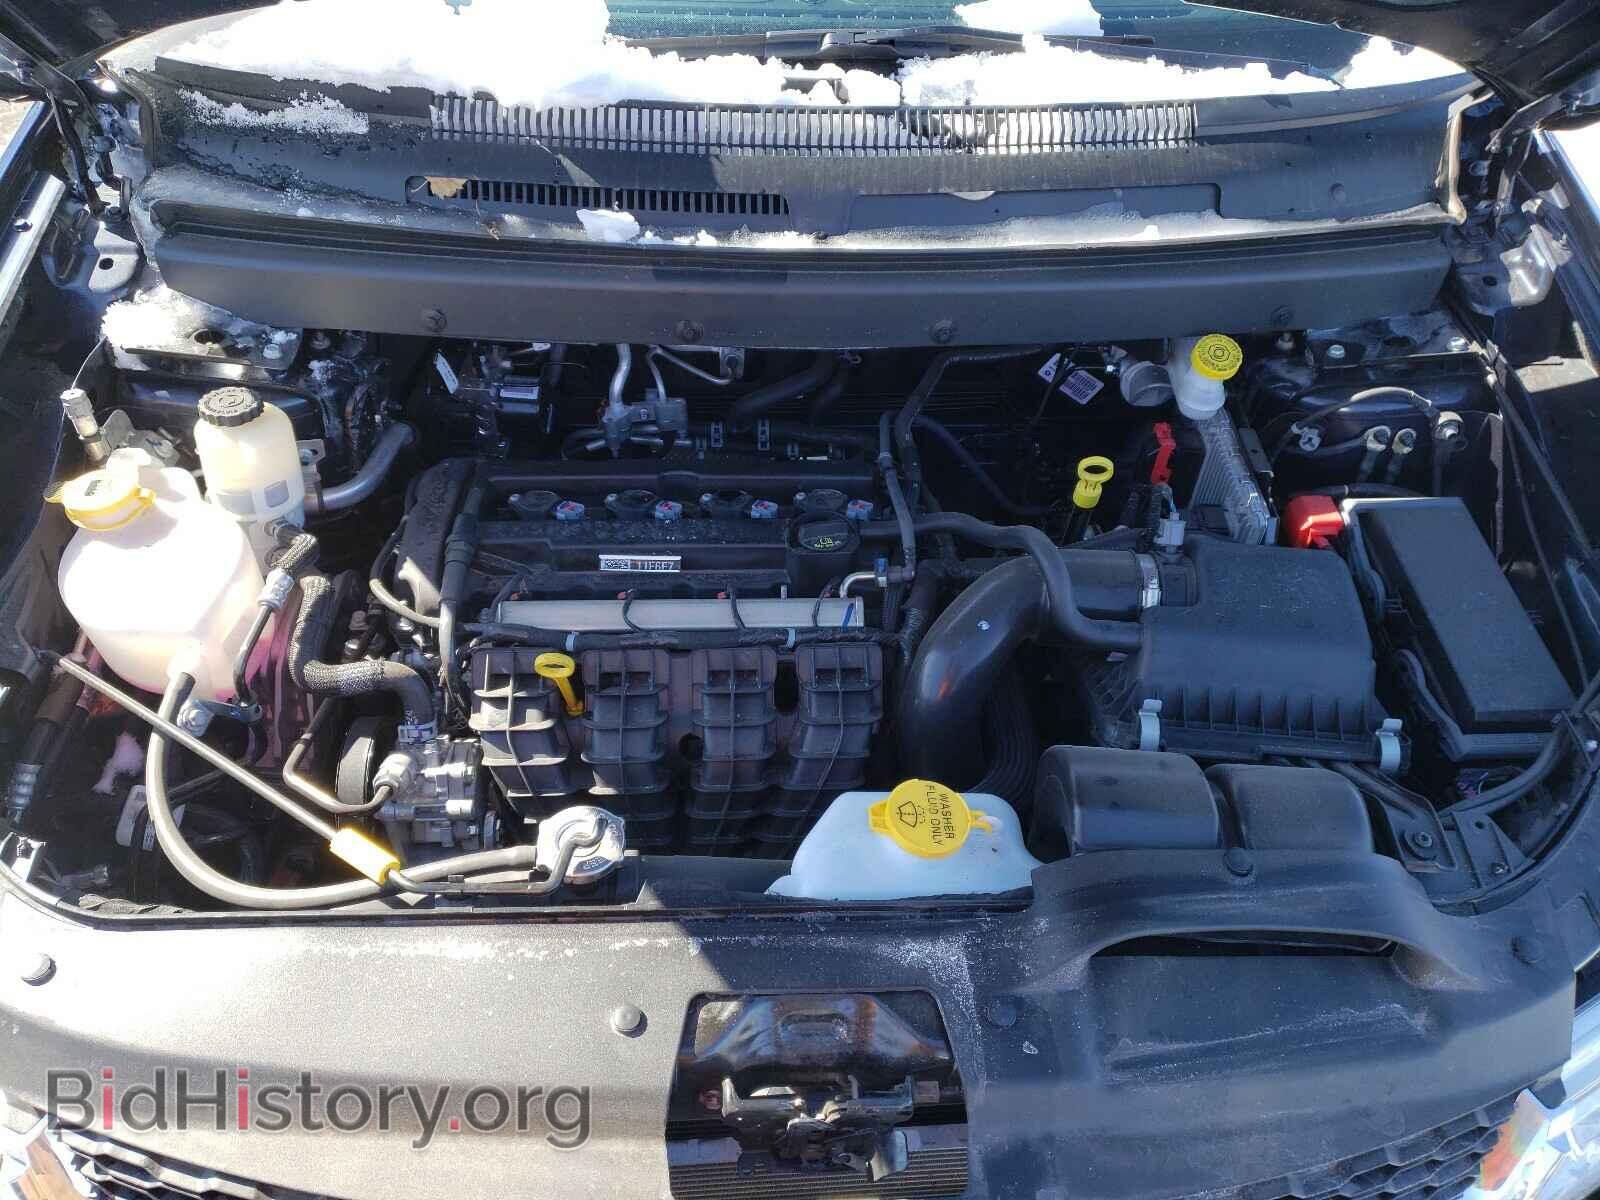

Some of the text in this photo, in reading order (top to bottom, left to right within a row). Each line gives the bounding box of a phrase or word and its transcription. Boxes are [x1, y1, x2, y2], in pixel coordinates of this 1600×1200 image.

[925, 784, 944, 846] FLUID ONLY
[939, 793, 955, 839] WASHER
